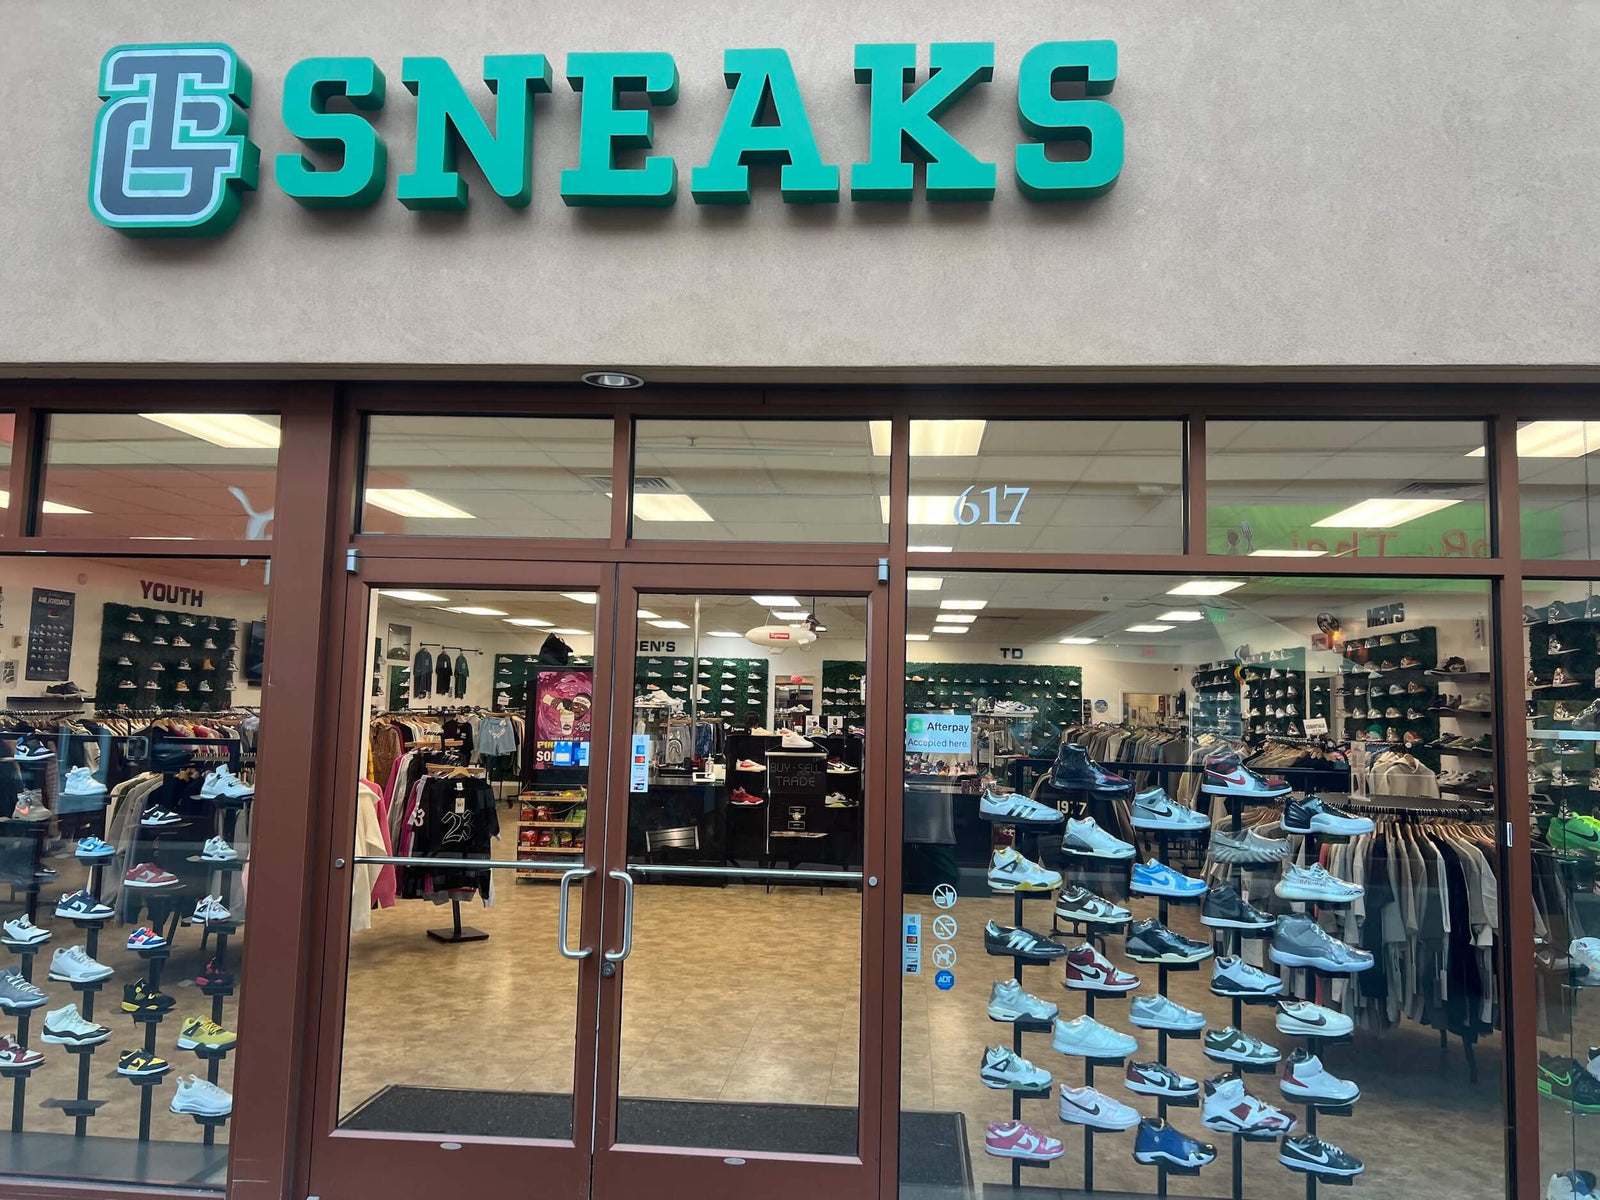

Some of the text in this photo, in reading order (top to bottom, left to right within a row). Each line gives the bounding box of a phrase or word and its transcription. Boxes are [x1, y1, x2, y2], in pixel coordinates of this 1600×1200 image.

[274, 40, 1125, 206] SNEAKS
[953, 484, 1031, 525] 617
[140, 580, 203, 607] YOUTH
[637, 640, 676, 652] EN'S
[1000, 647, 1024, 660] TD
[927, 722, 970, 733] Afterpay
[907, 738, 969, 748] Accepted here.
[770, 762, 791, 773] BUY
[797, 762, 822, 774] SELL
[775, 775, 816, 787] TRADE
[441, 809, 473, 845] 23
[938, 976, 952, 984] ADT
